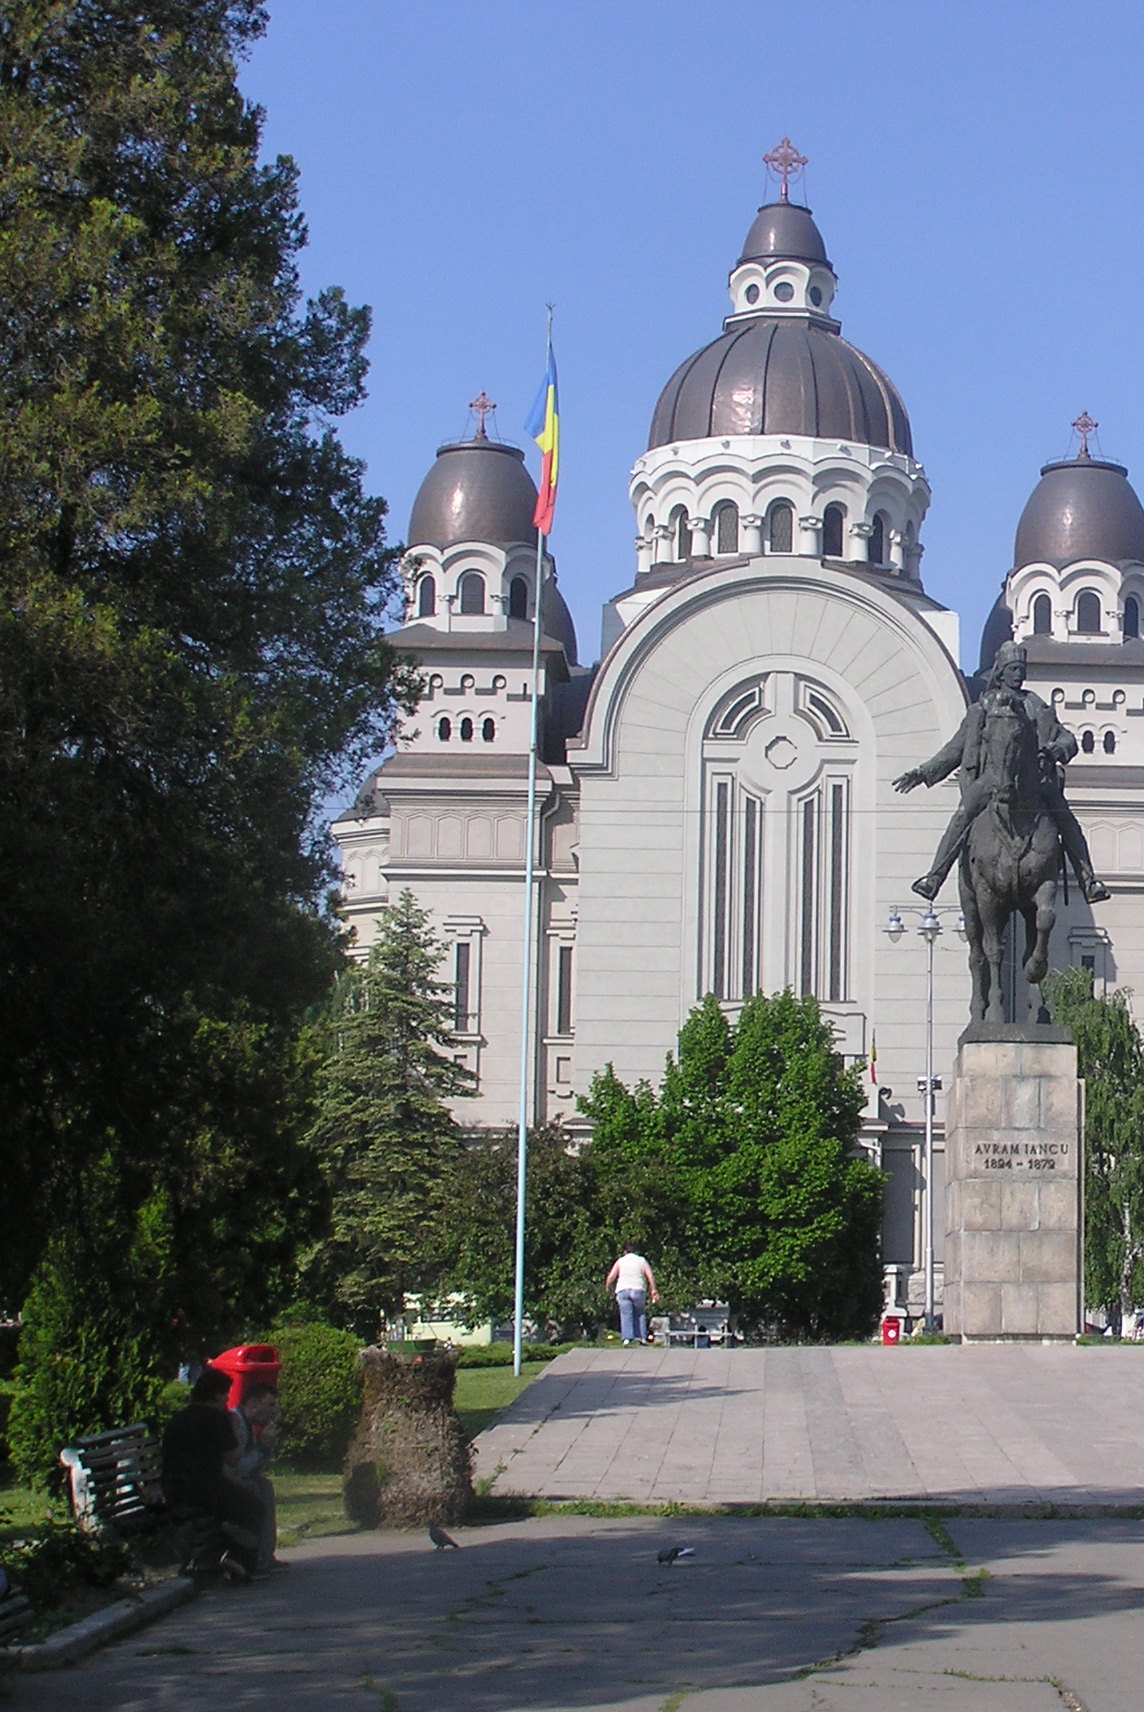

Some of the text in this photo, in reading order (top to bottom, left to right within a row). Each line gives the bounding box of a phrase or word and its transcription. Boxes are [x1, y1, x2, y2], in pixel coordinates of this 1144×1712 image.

[975, 1143, 1069, 1155] AVRAM IANCU
[984, 1159, 1013, 1170] 1824
[1027, 1159, 1056, 1170] 1872
